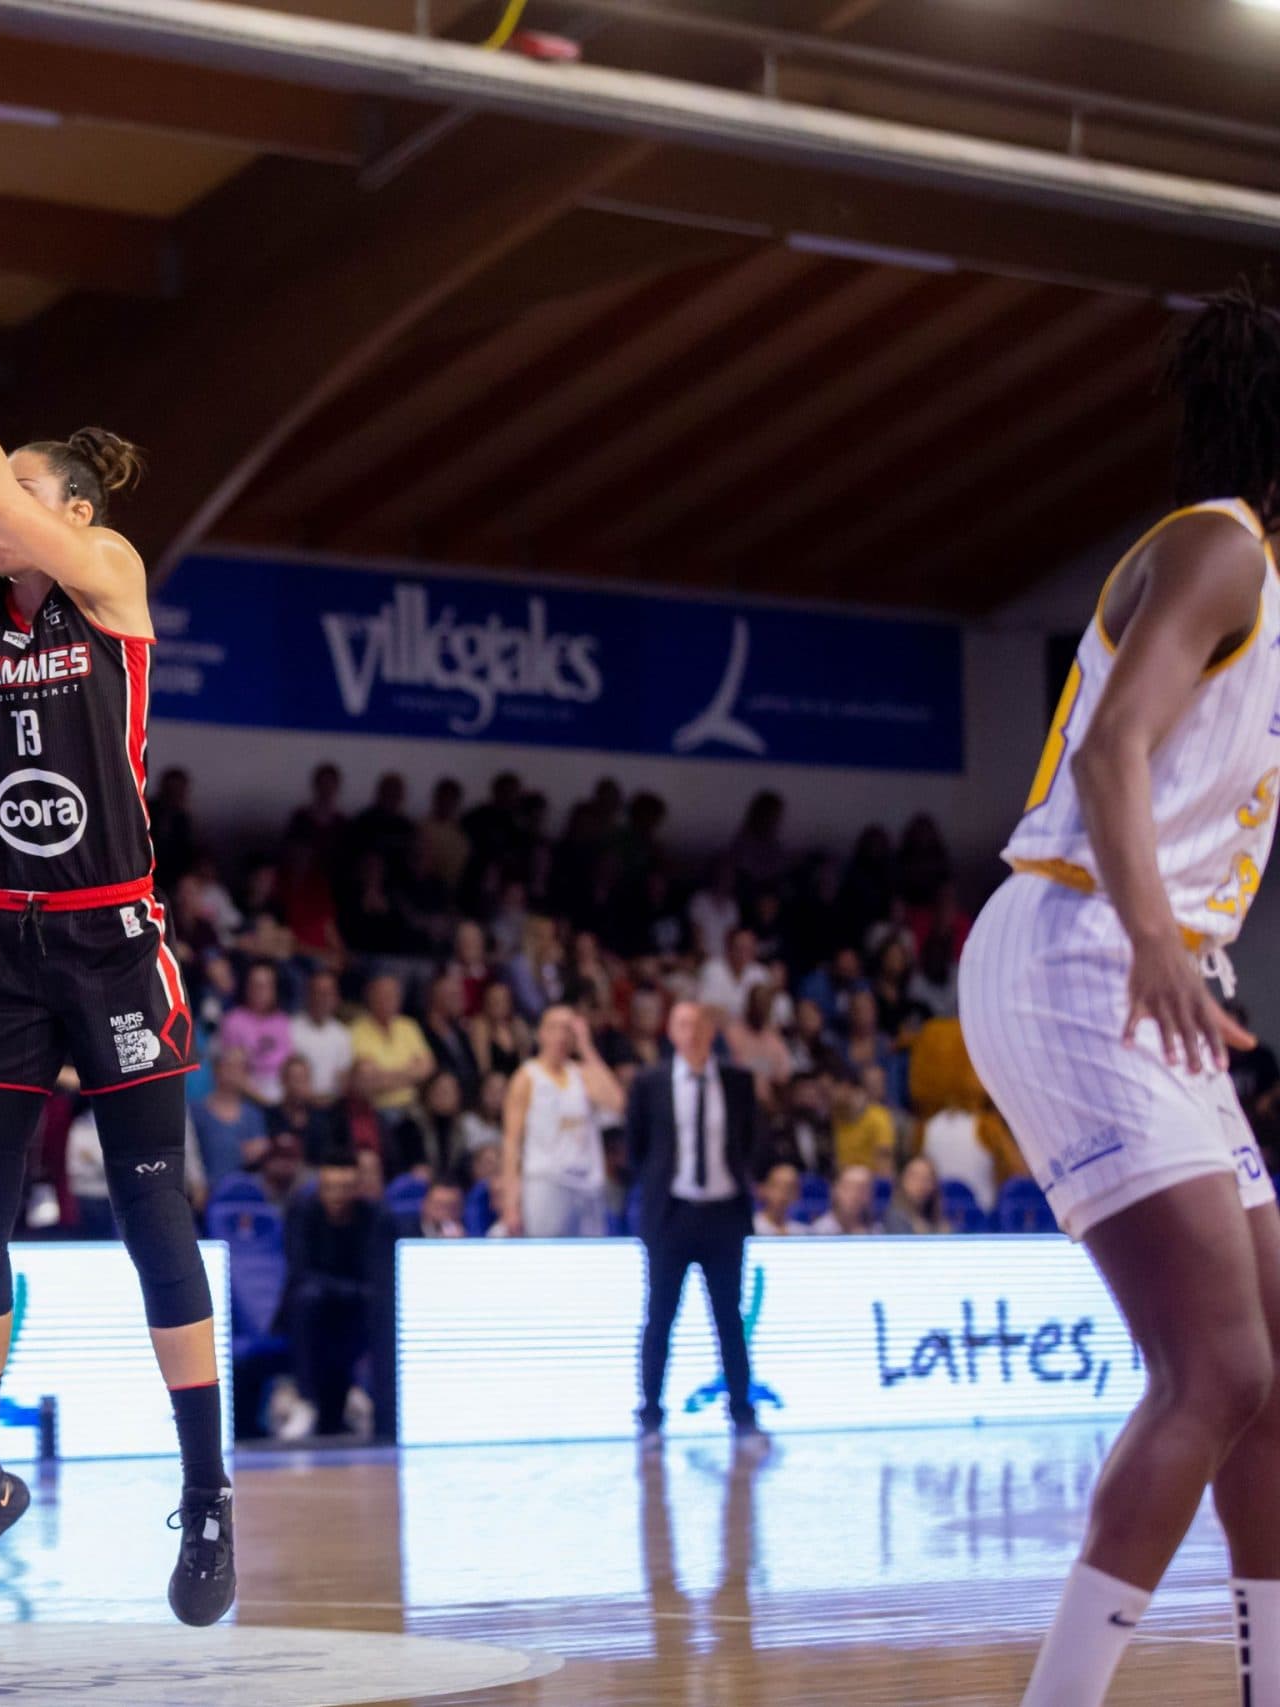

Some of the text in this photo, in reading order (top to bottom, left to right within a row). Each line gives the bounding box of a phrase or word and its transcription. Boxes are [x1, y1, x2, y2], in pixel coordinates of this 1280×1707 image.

[10, 709, 43, 757] 13
[0, 796, 81, 828] cora
[110, 1011, 144, 1028] MURS
[872, 1299, 1110, 1398] Lattes,
